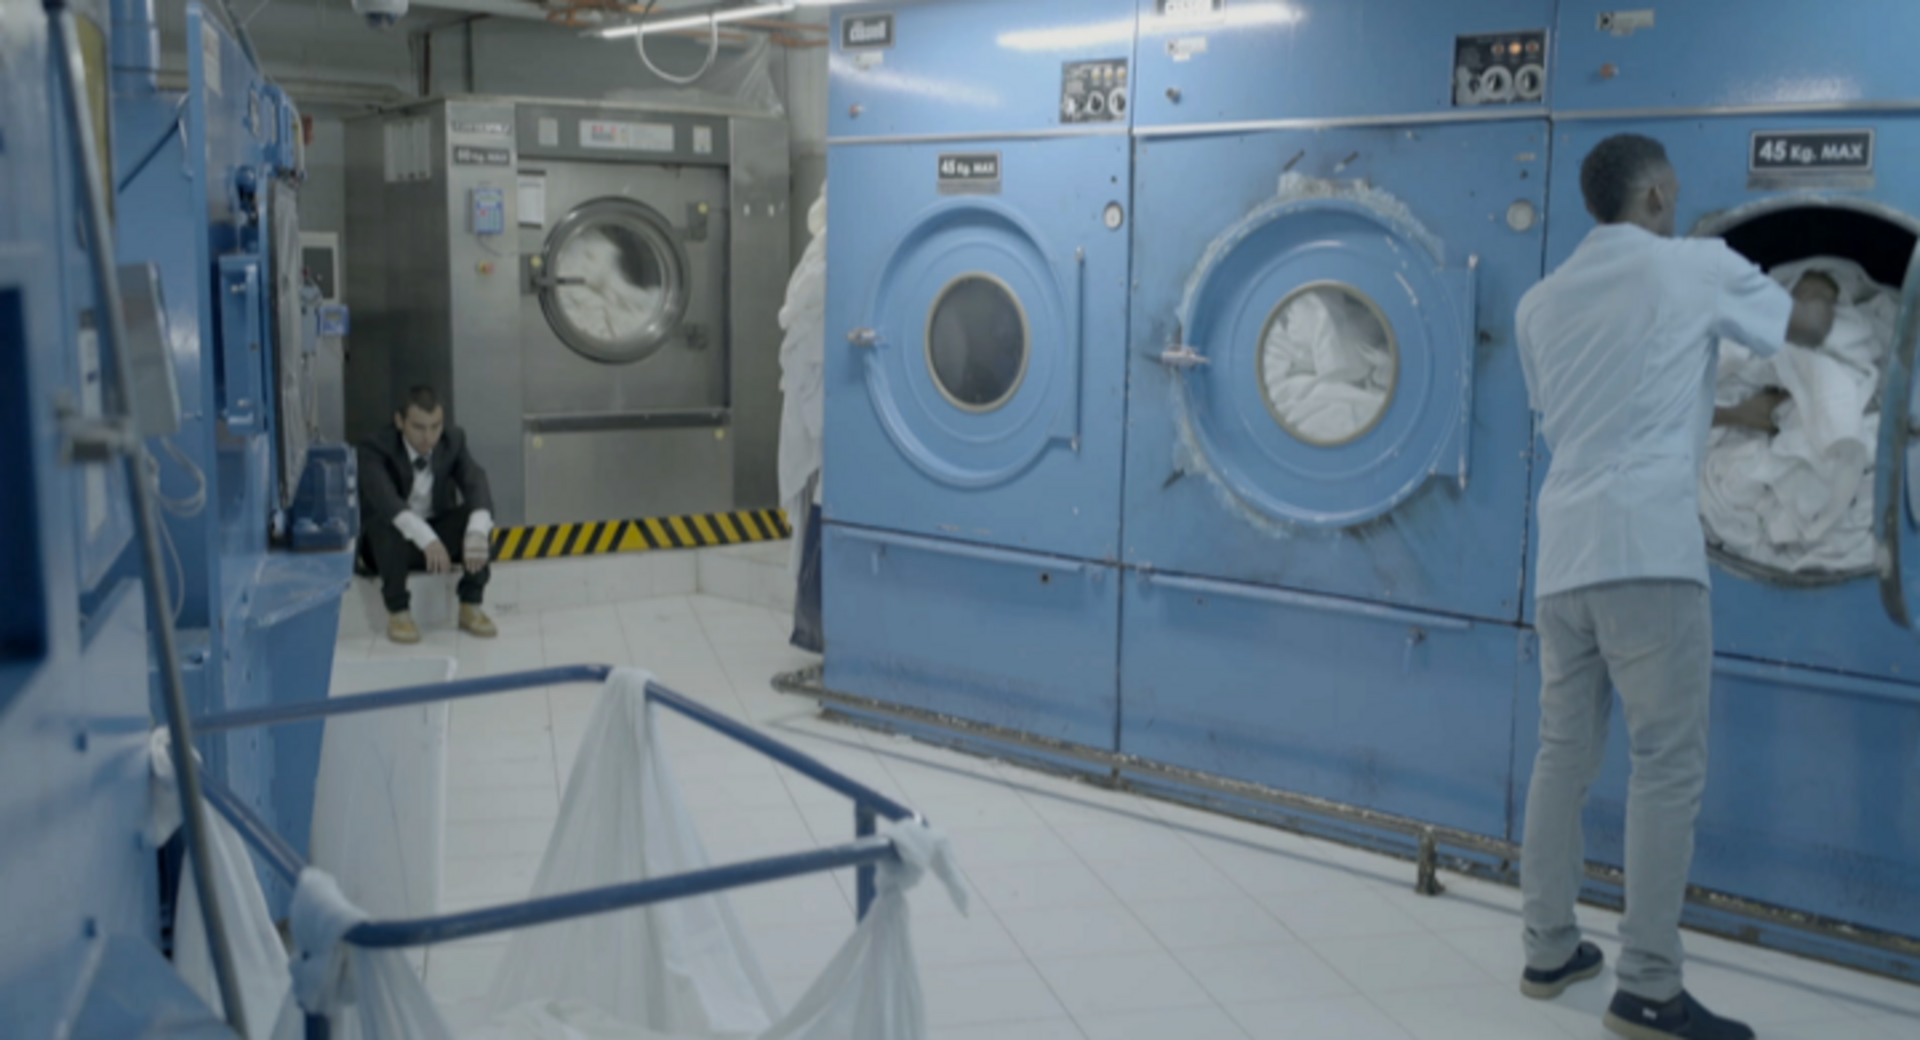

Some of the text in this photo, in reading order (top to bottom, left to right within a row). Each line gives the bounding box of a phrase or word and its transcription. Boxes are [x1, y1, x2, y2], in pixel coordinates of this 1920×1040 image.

[1759, 138, 1863, 164] 45 Kg. MAX
[941, 159, 955, 175] 45
[973, 161, 995, 174] MAX
